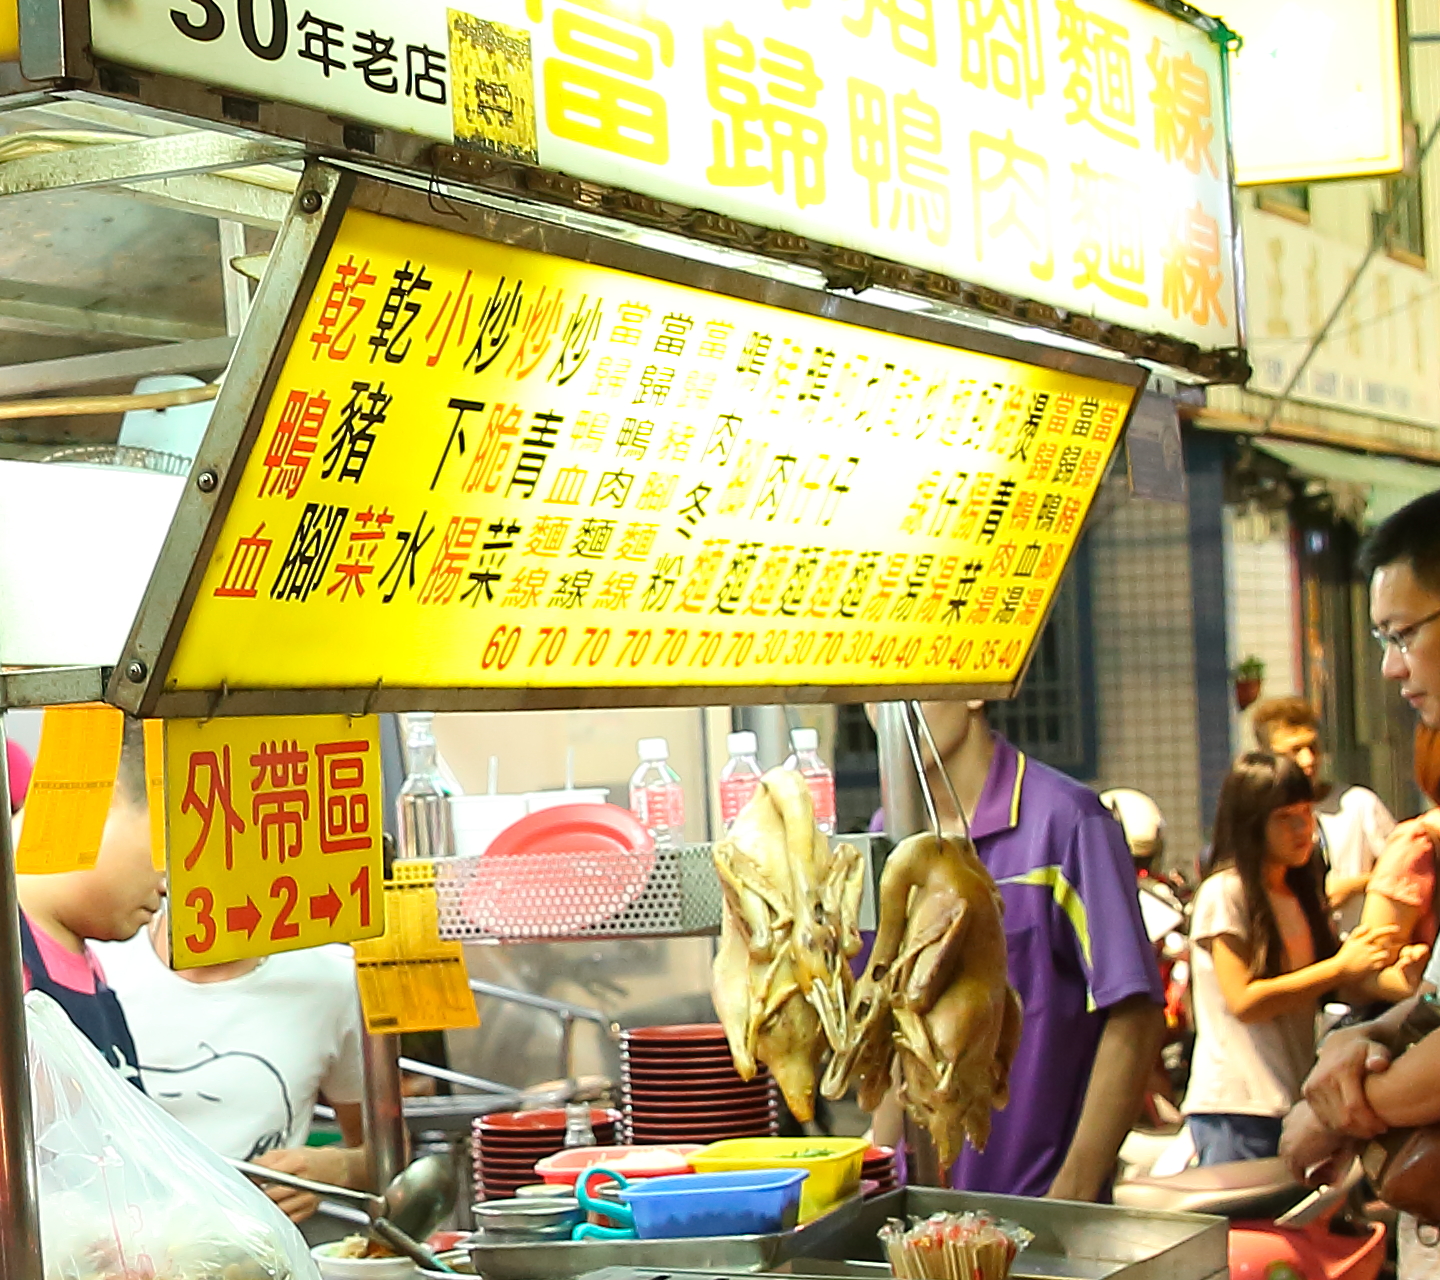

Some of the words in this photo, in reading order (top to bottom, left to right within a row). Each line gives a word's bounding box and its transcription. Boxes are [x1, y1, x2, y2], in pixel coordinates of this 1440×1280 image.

[213, 255, 376, 600] 乾鴨血
[270, 260, 431, 604] 乾豬腳
[326, 269, 474, 603] 小菜
[378, 276, 523, 605] 炒下水
[460, 292, 604, 608] 炒青菜
[180, 738, 372, 871] 外帶區
[481, 624, 522, 670] 60
[527, 627, 568, 667] 70
[573, 627, 611, 667] 70
[616, 629, 652, 667] 70
[653, 628, 688, 668] 70
[688, 630, 722, 668] 70
[721, 630, 755, 667] 70
[756, 629, 788, 664] 30
[784, 629, 816, 665] 30
[813, 632, 844, 665] 70
[843, 630, 874, 664] 30
[870, 635, 897, 669] 40
[184, 886, 216, 954] 3
[268, 876, 301, 941] 2
[349, 865, 372, 928] 1
